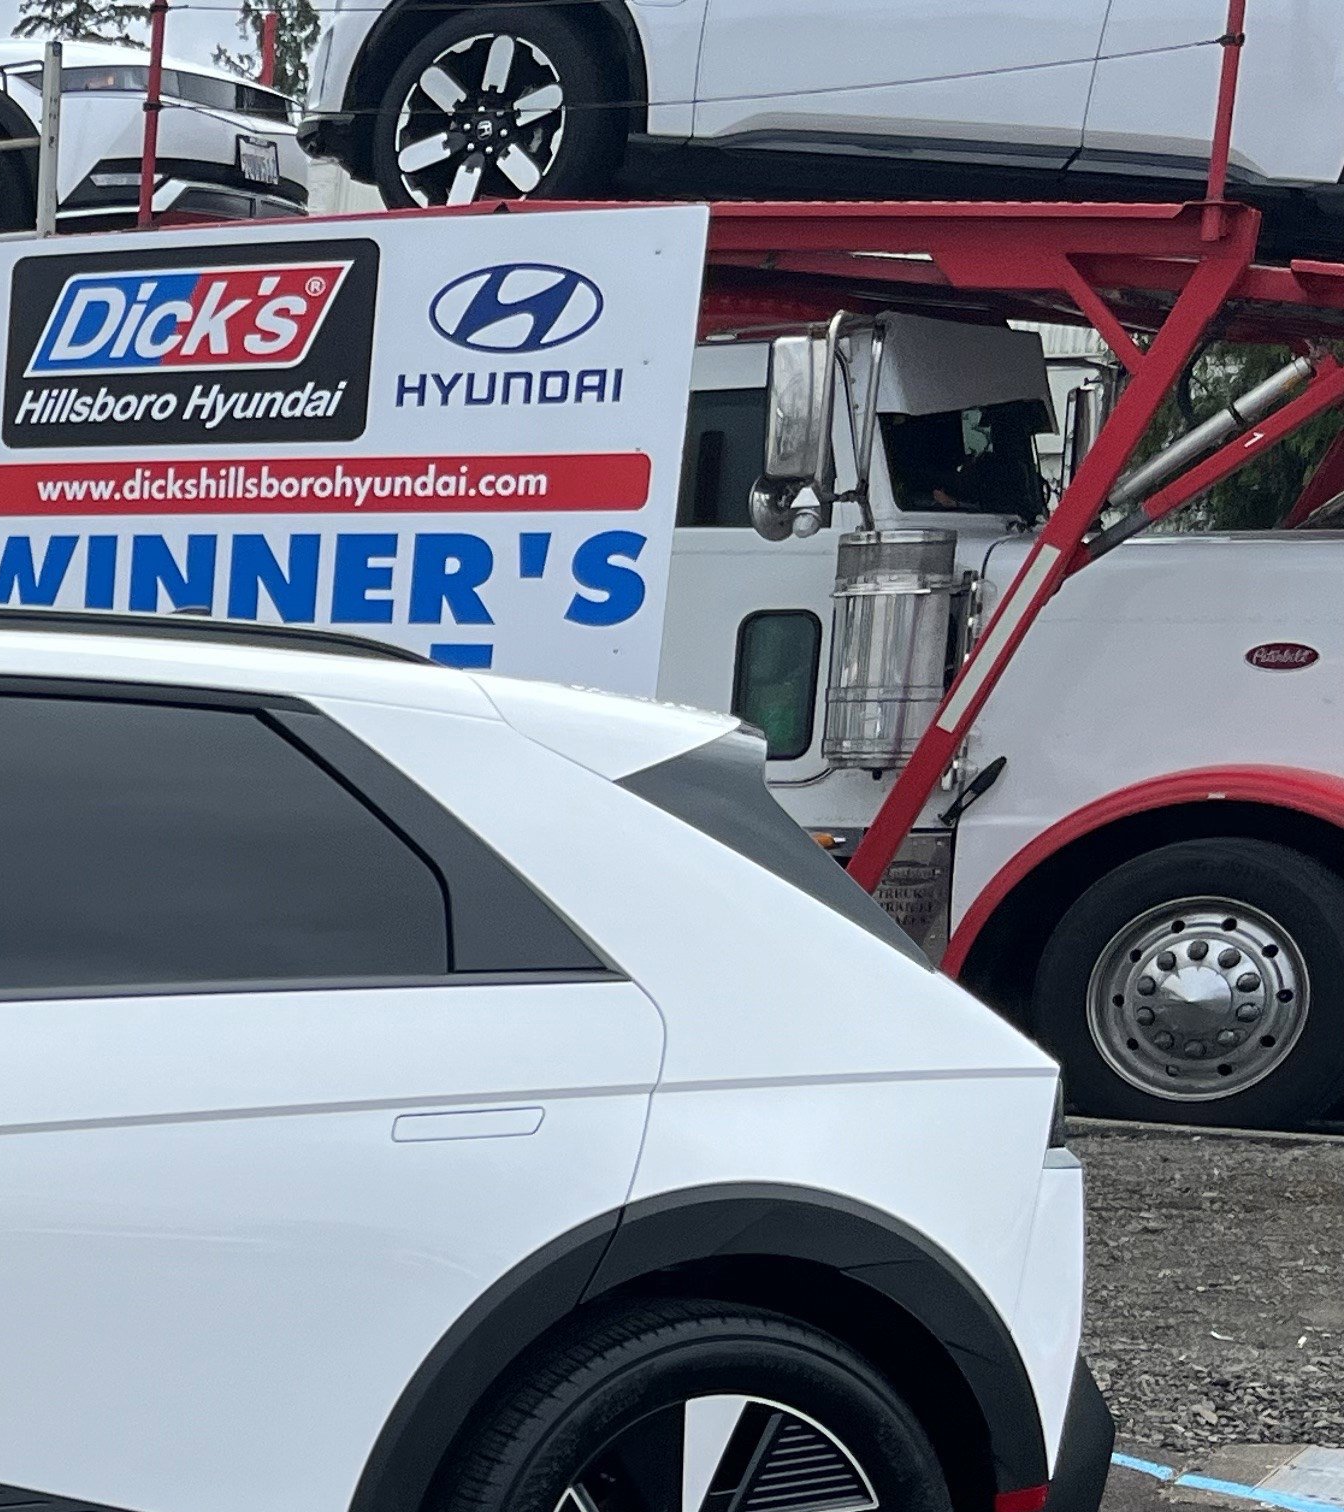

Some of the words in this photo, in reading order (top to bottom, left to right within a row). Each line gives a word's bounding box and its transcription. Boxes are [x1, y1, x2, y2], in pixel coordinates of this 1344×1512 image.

[48, 274, 307, 361] Dick's
[14, 387, 177, 425] Hillsboro
[181, 381, 349, 429] Hyundai
[395, 368, 624, 407] HYUNDAI
[37, 463, 548, 507] www.dickshillsborohyundai.com
